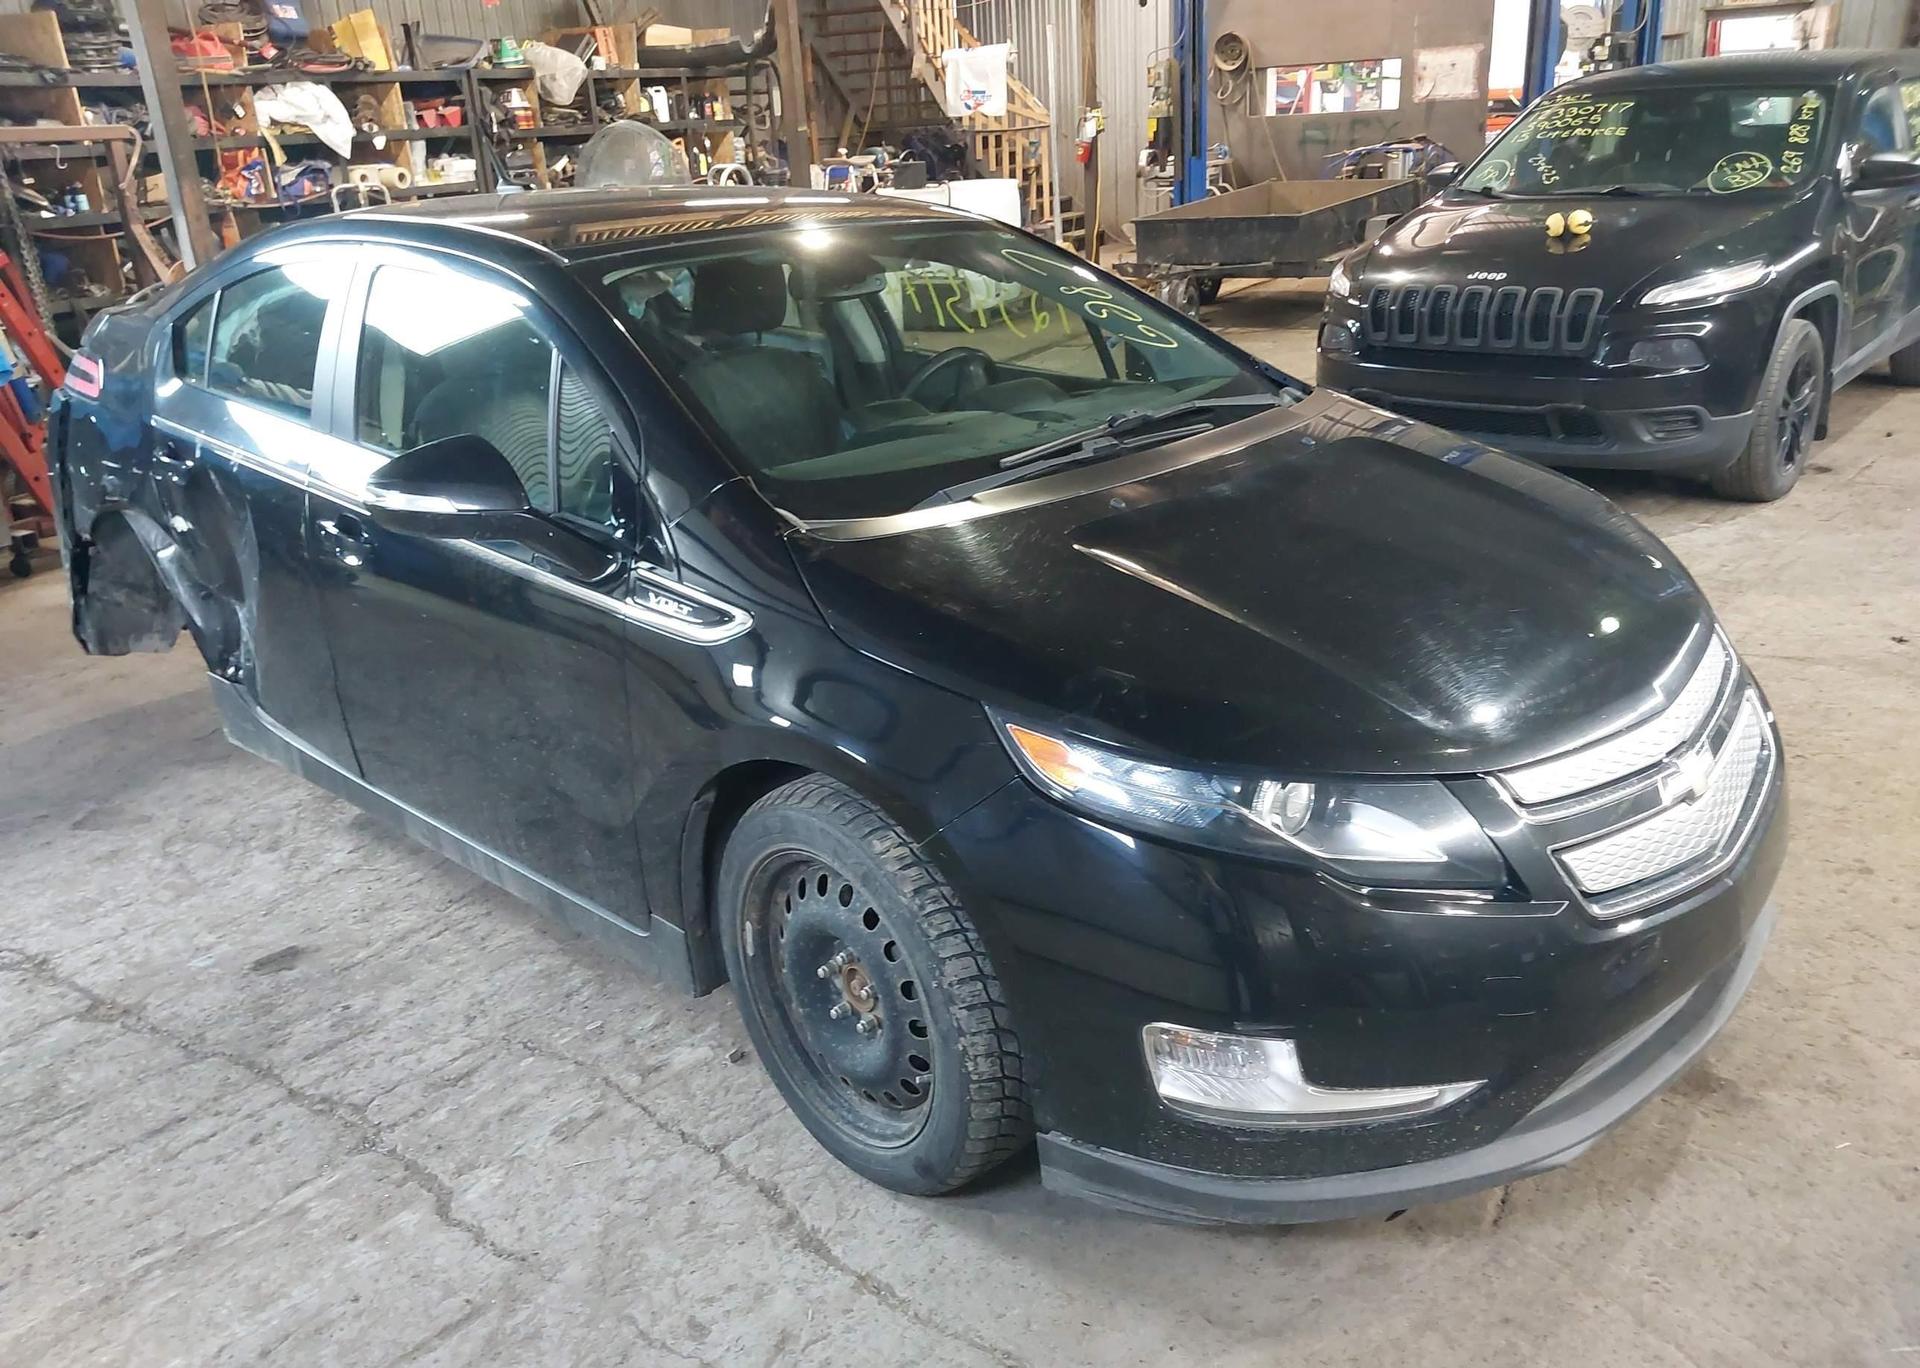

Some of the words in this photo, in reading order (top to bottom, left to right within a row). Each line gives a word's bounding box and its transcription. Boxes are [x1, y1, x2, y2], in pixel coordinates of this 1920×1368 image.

[1536, 126, 1630, 139] CHEROKEE
[1466, 270, 1508, 281] Jeep
[648, 591, 694, 616] VOLT
